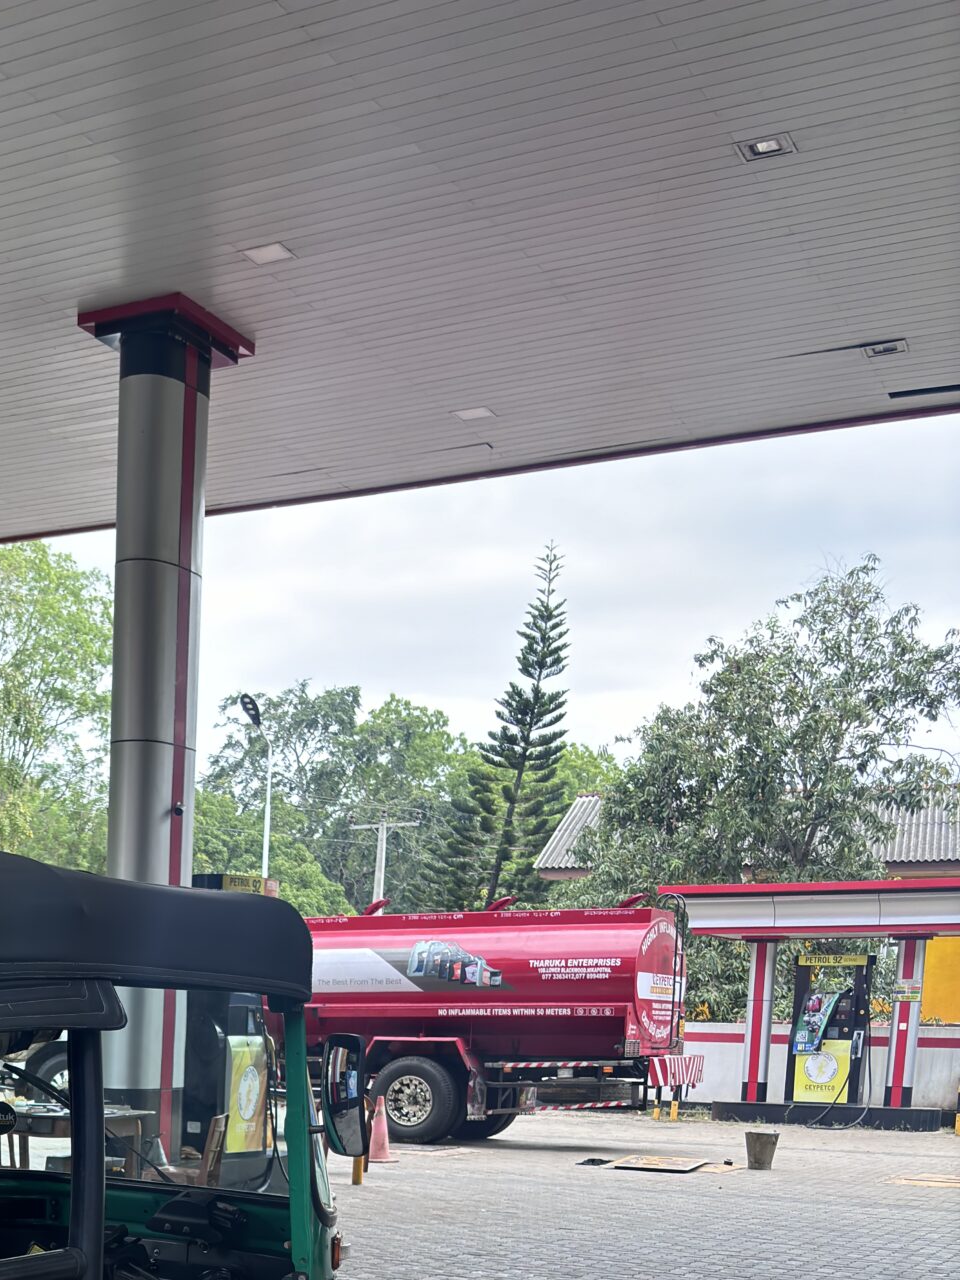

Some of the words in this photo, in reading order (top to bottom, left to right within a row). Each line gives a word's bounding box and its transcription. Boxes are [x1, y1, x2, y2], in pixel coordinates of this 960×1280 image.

[229, 877, 250, 888] PETROL
[252, 879, 262, 893] 92
[641, 924, 658, 955] HIGHLY
[528, 959, 566, 968] THARUKA
[567, 958, 621, 967] ENTERPRISES
[805, 956, 831, 964] PETROL
[832, 955, 843, 964] 92
[318, 978, 330, 986] The
[332, 978, 348, 986] Best
[349, 978, 369, 986] From
[438, 1008, 447, 1016] NO
[448, 1008, 491, 1016] INFLAMMABLE
[492, 1008, 511, 1016] ITEMS
[512, 1008, 535, 1016] WITHIN
[536, 1008, 544, 1016] 50
[545, 1008, 571, 1016] METERS
